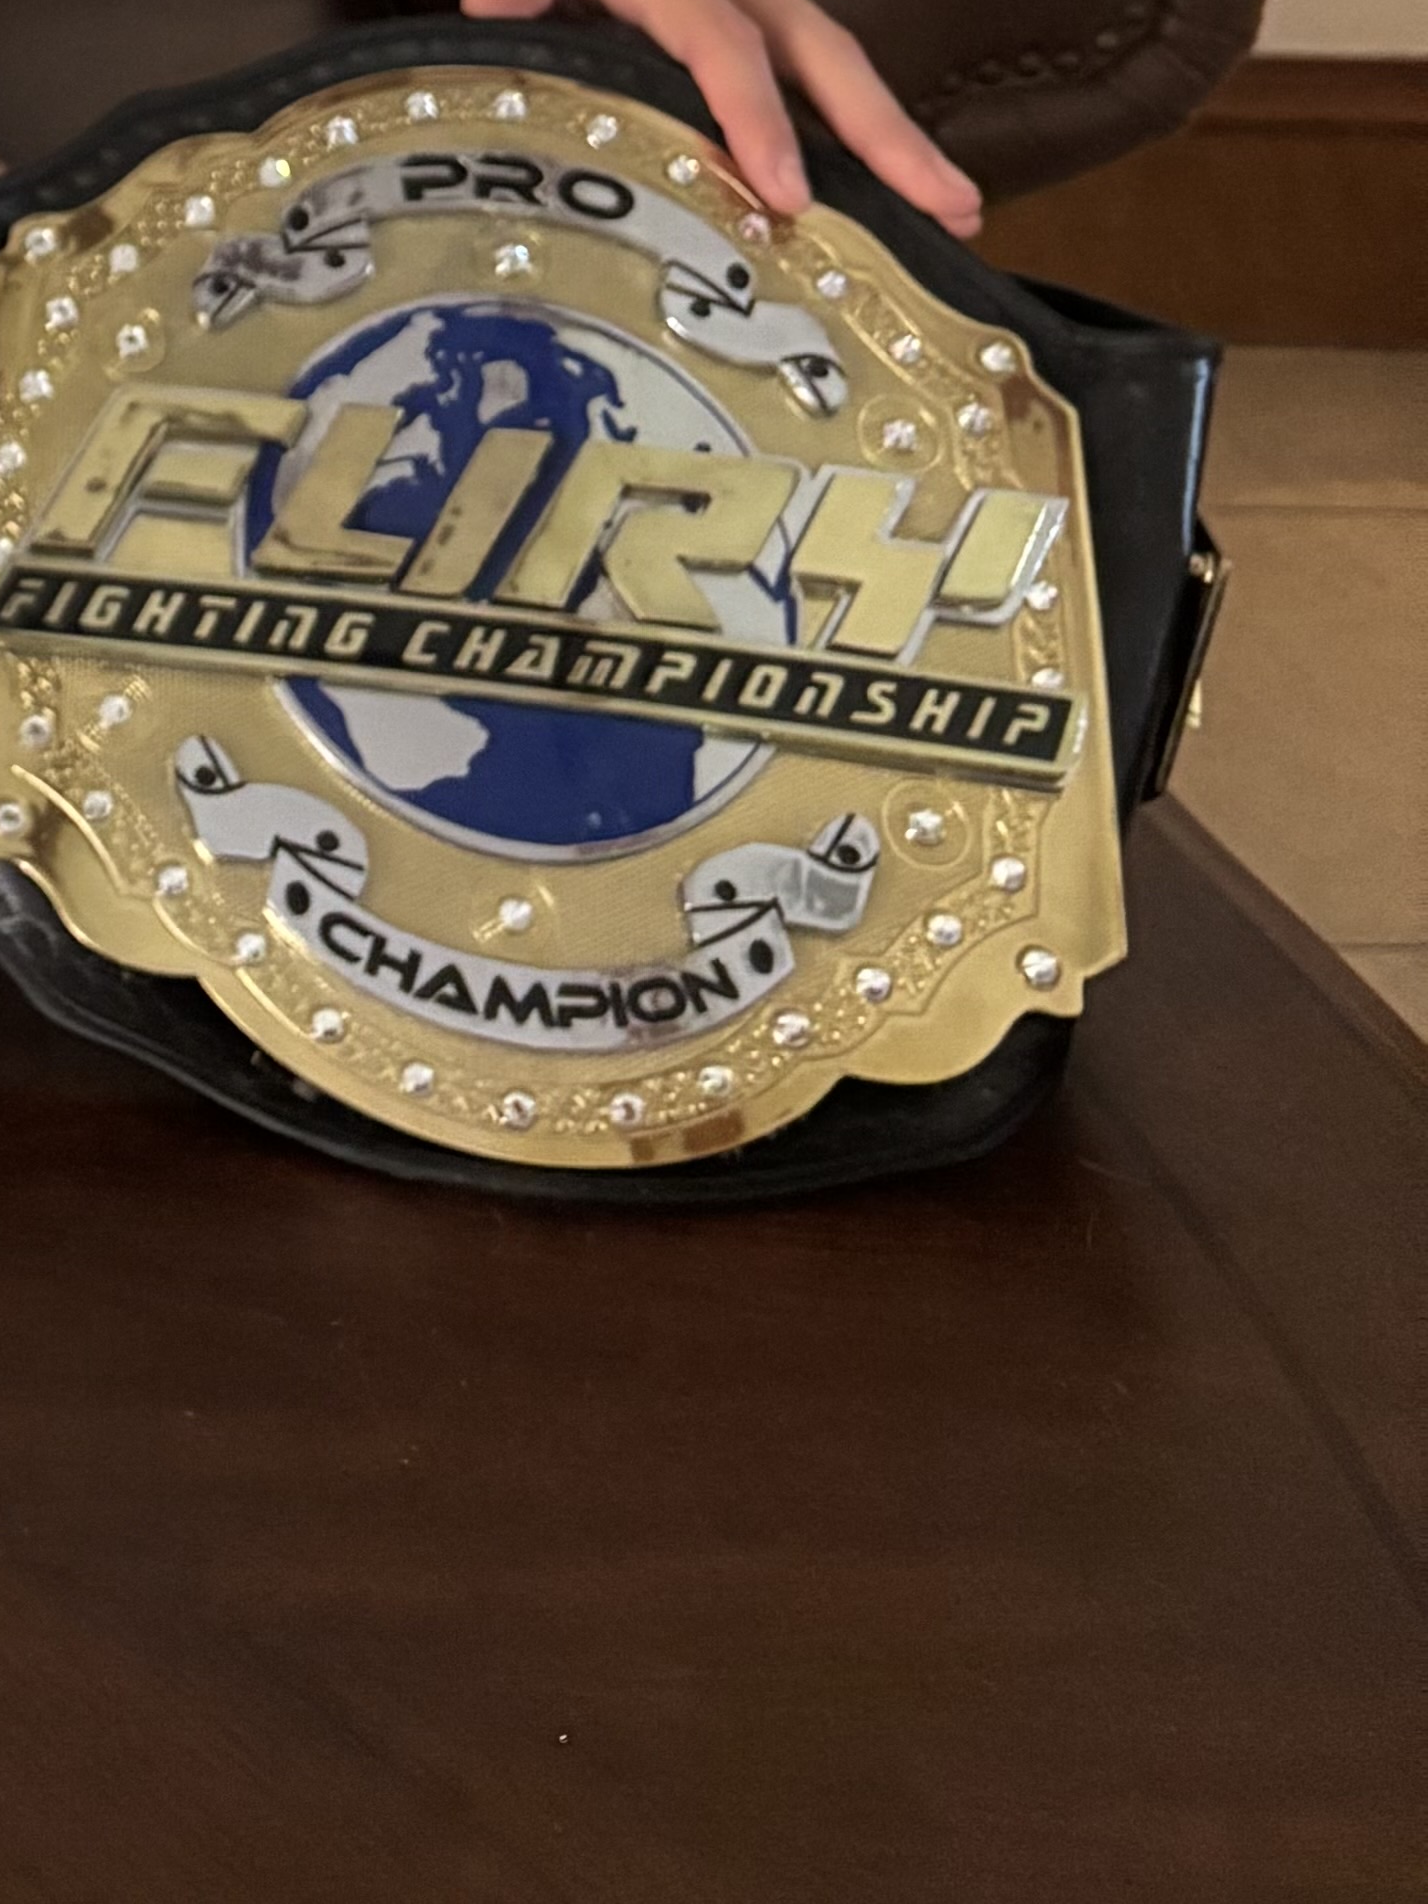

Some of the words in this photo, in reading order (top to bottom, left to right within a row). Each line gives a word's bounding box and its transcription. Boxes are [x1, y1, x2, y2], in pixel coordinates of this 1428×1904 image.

[402, 154, 634, 222] PRO
[19, 384, 1069, 661] FURY
[0, 576, 371, 661] FIGHTING
[402, 620, 1054, 749] CHAMPIONSHIP
[316, 906, 741, 1029] CHAMPION
